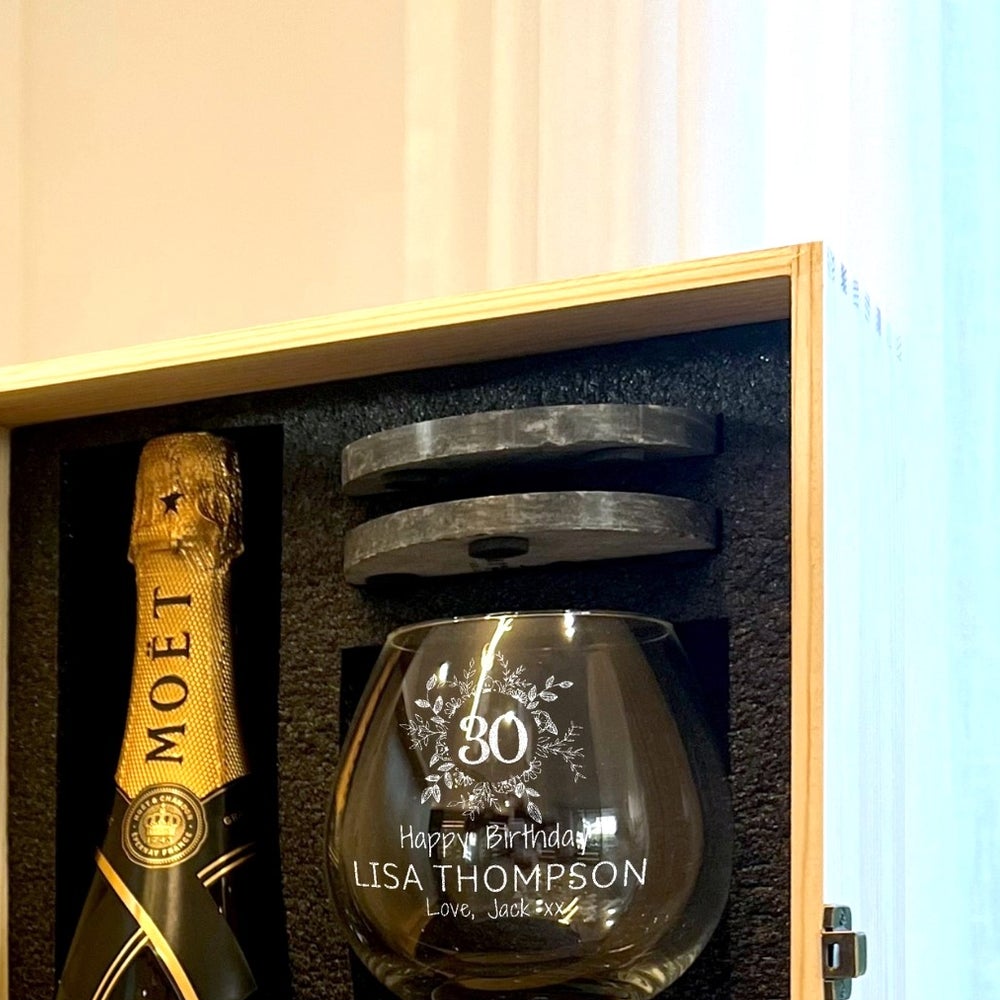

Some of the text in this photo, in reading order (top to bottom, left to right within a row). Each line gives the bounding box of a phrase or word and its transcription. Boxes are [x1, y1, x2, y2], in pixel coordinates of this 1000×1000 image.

[145, 587, 192, 764] MOËT
[458, 712, 528, 765] 30
[400, 824, 588, 857] Happy Birthday
[353, 859, 648, 893] LISA THOMPSON
[427, 898, 475, 920] Love,
[488, 899, 529, 918] Jack
